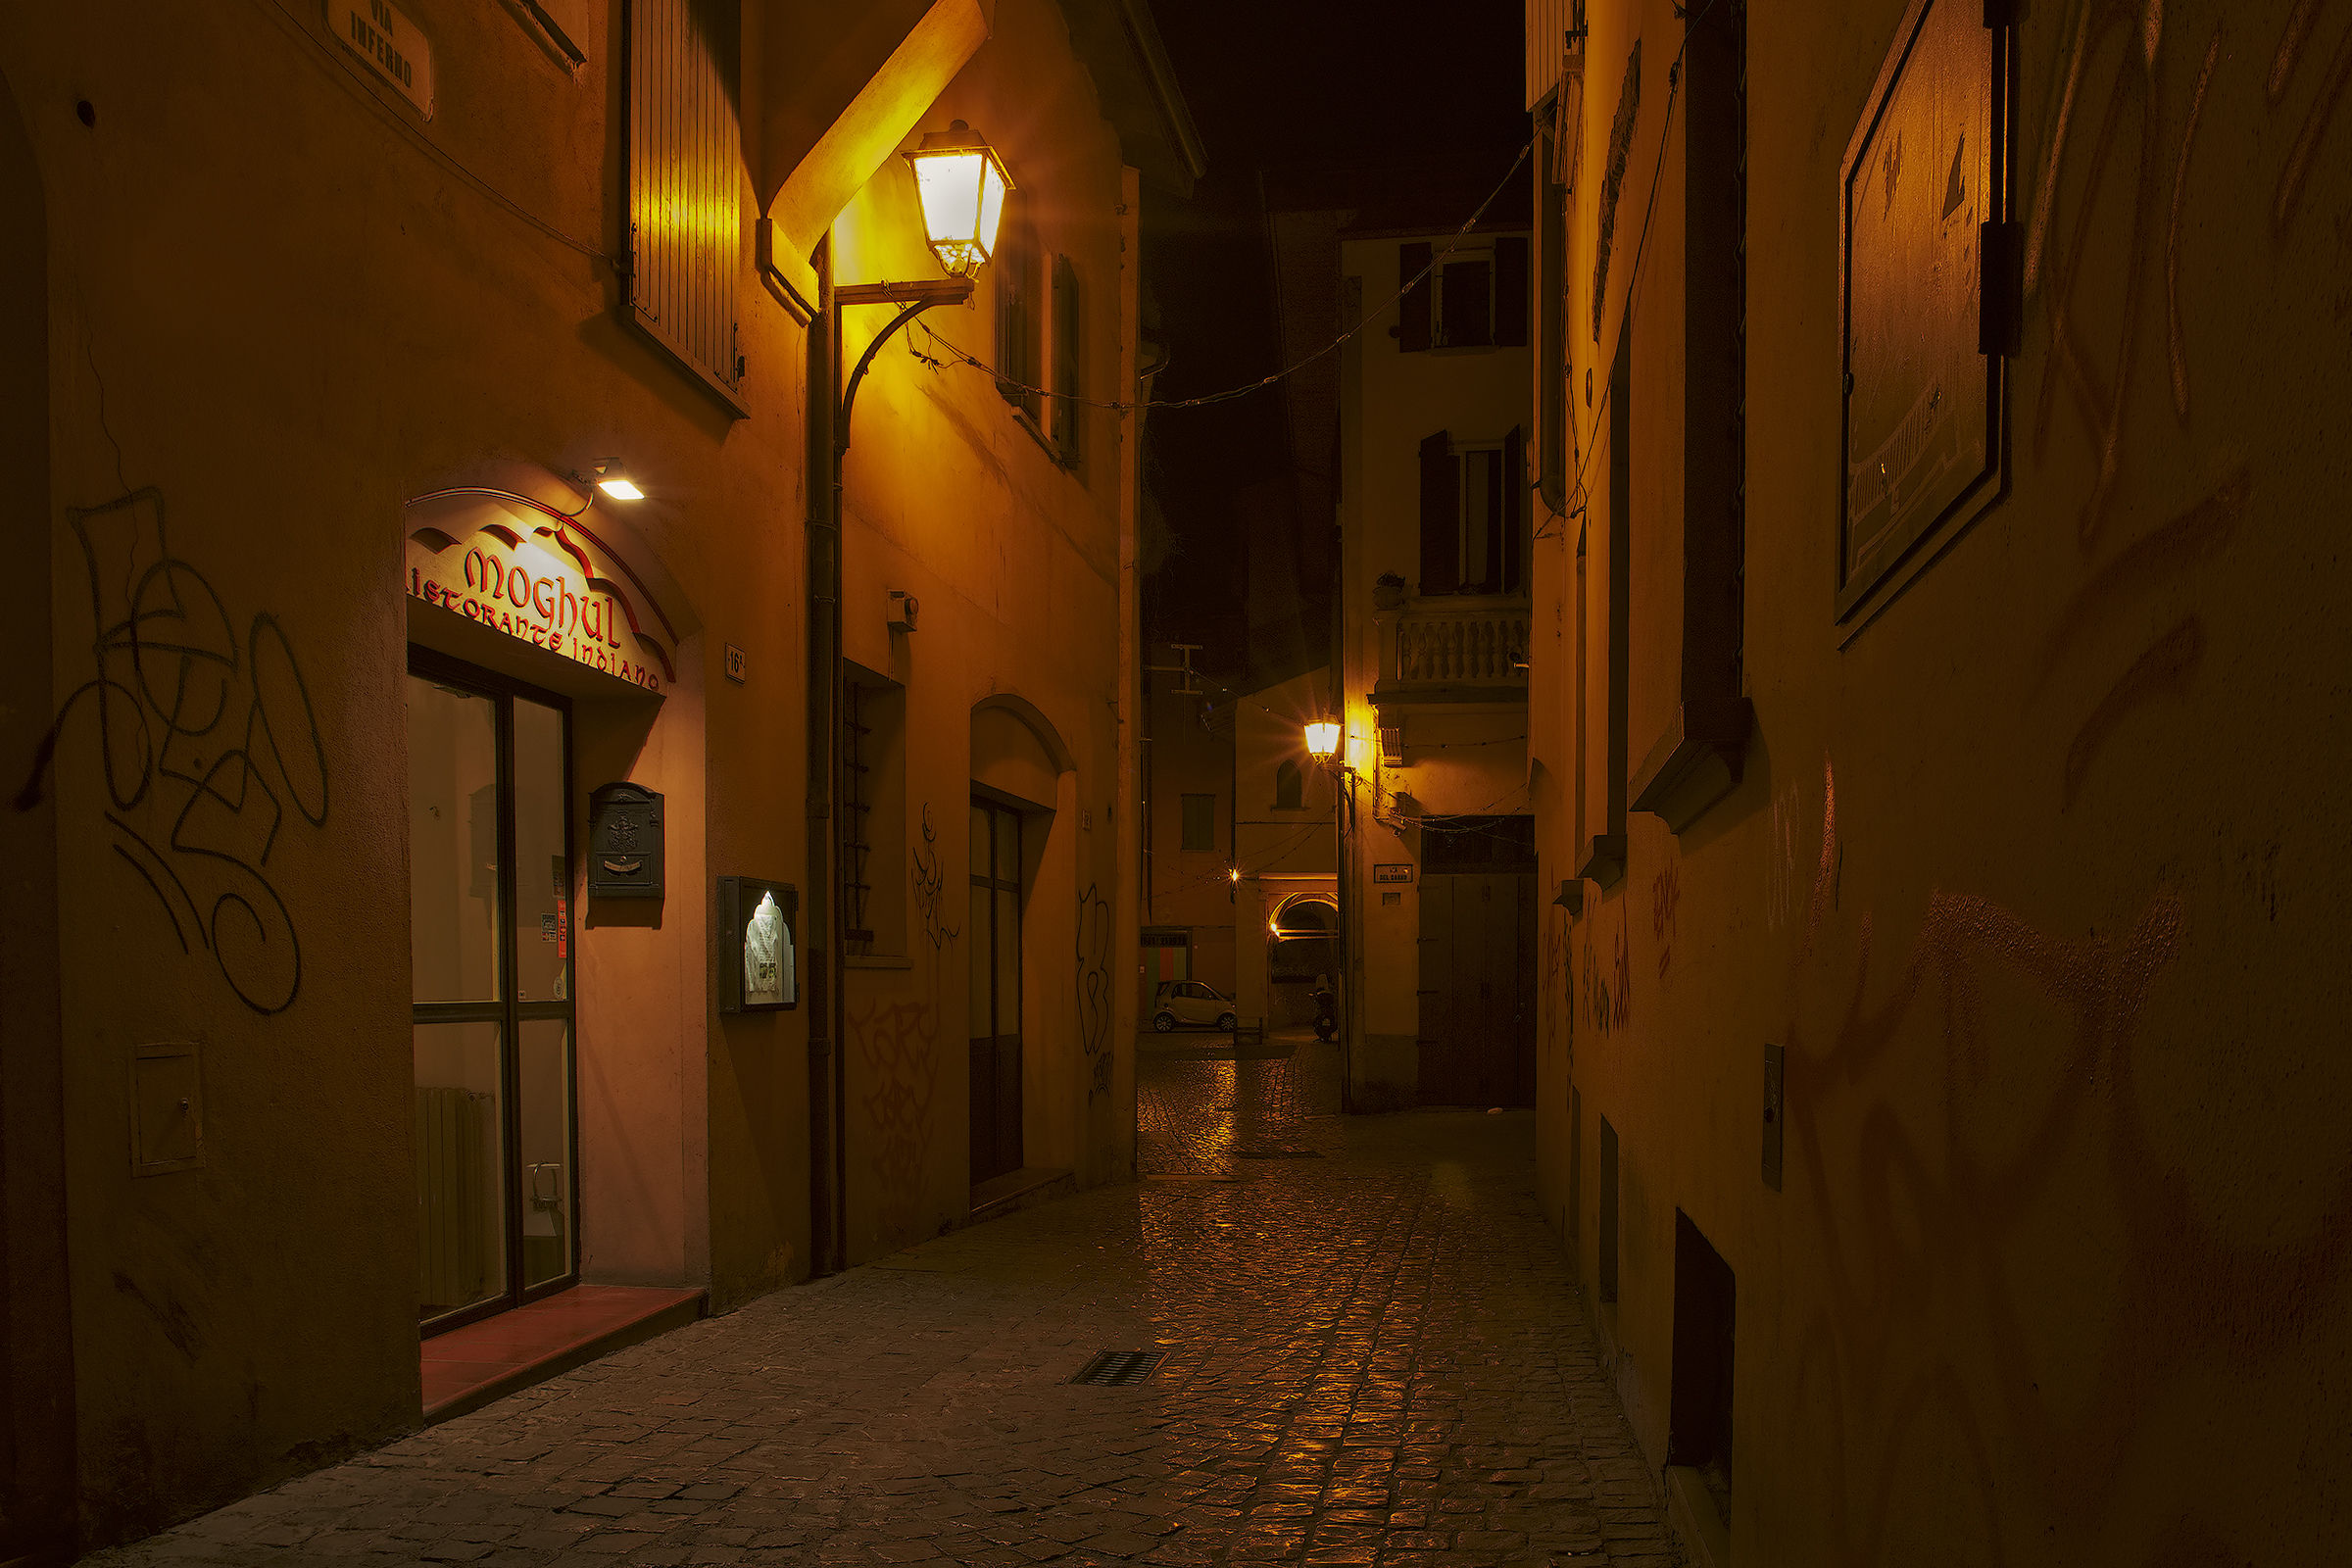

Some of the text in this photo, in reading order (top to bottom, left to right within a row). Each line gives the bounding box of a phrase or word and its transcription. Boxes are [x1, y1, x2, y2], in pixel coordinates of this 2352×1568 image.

[350, 10, 412, 88] INFERNO
[369, 0, 394, 37] VIA
[407, 566, 564, 654] ISTORANTE
